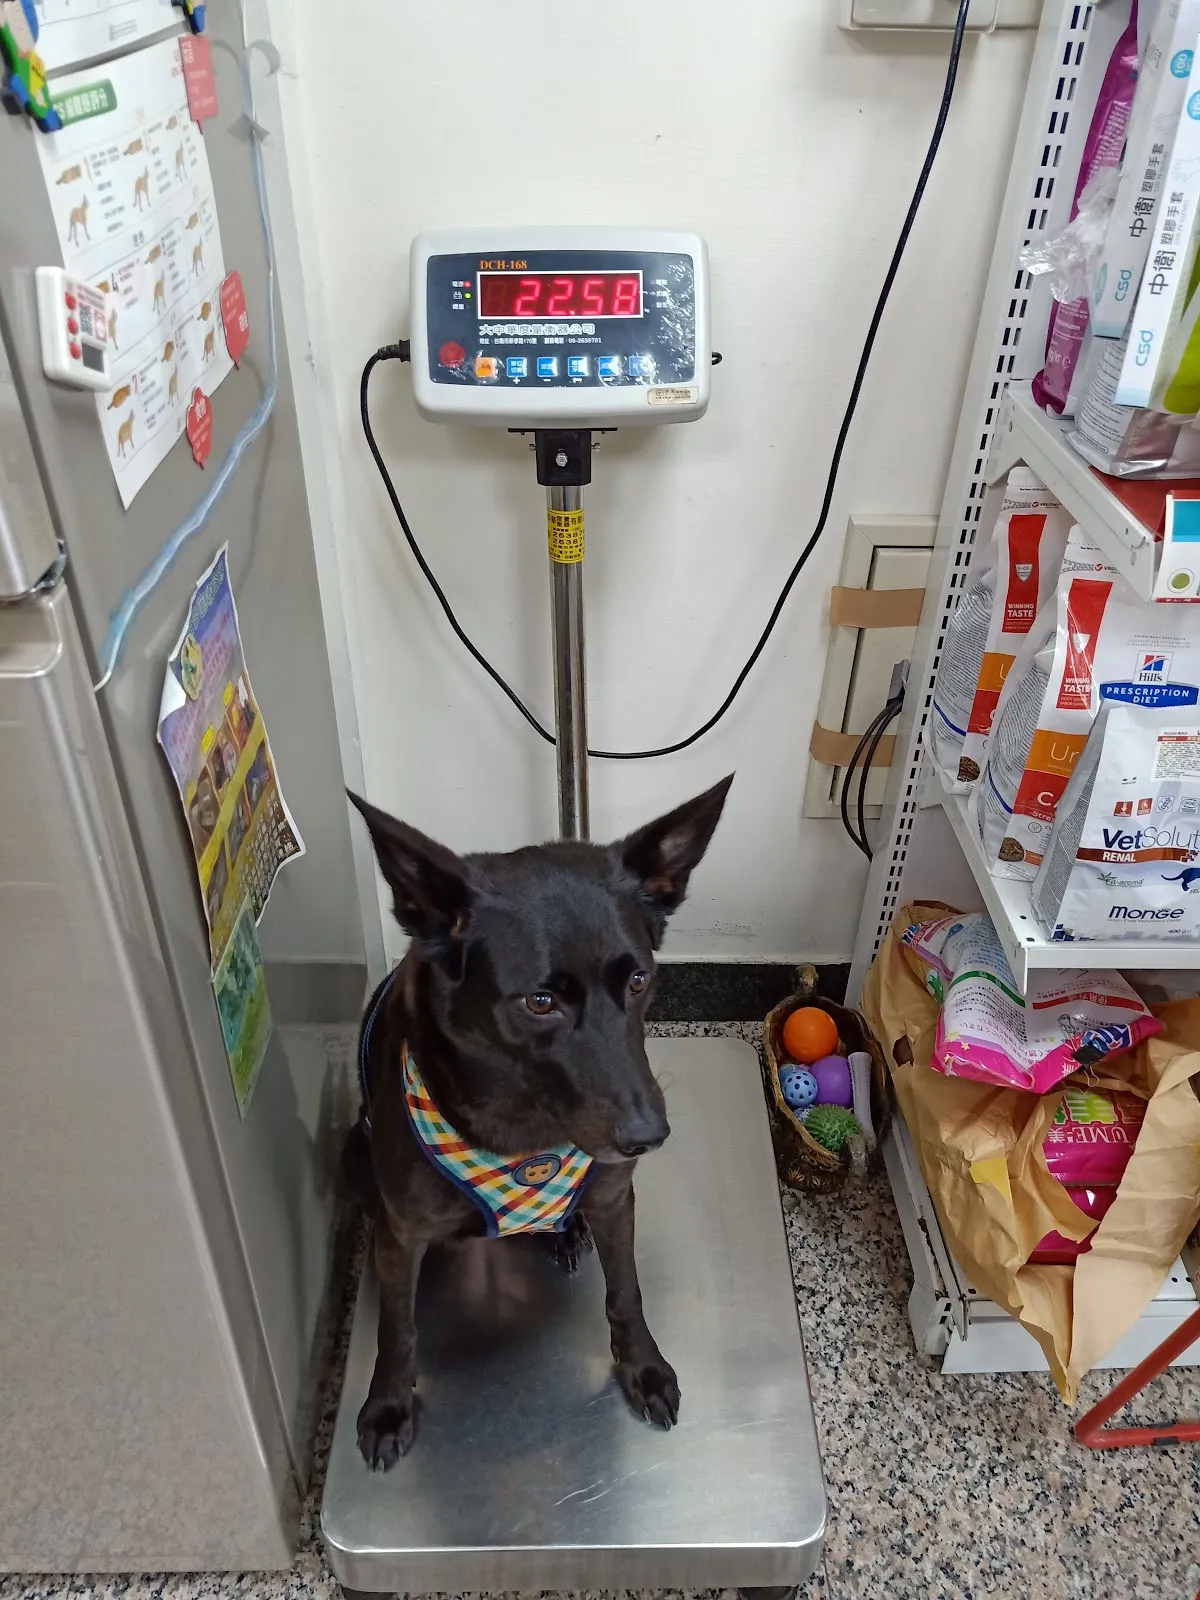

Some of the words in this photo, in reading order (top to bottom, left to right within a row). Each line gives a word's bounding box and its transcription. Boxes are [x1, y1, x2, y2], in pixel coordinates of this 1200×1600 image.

[1141, 143, 1164, 193] 塑膠手套
[1129, 196, 1156, 238] 中衛
[1160, 191, 1184, 245] 塑膠手套
[480, 259, 528, 270] DCH-168
[1148, 249, 1177, 295] 中衛
[1114, 269, 1133, 302] csd
[514, 279, 638, 315] 22.58
[1135, 329, 1154, 367] csd
[1008, 610, 1034, 618] TASTE
[1139, 672, 1163, 682] Hill's
[1064, 684, 1090, 693] TASTE
[1106, 686, 1190, 697] PRESCRIPTION
[1133, 695, 1159, 704] DIET
[1103, 851, 1136, 862] RENAL
